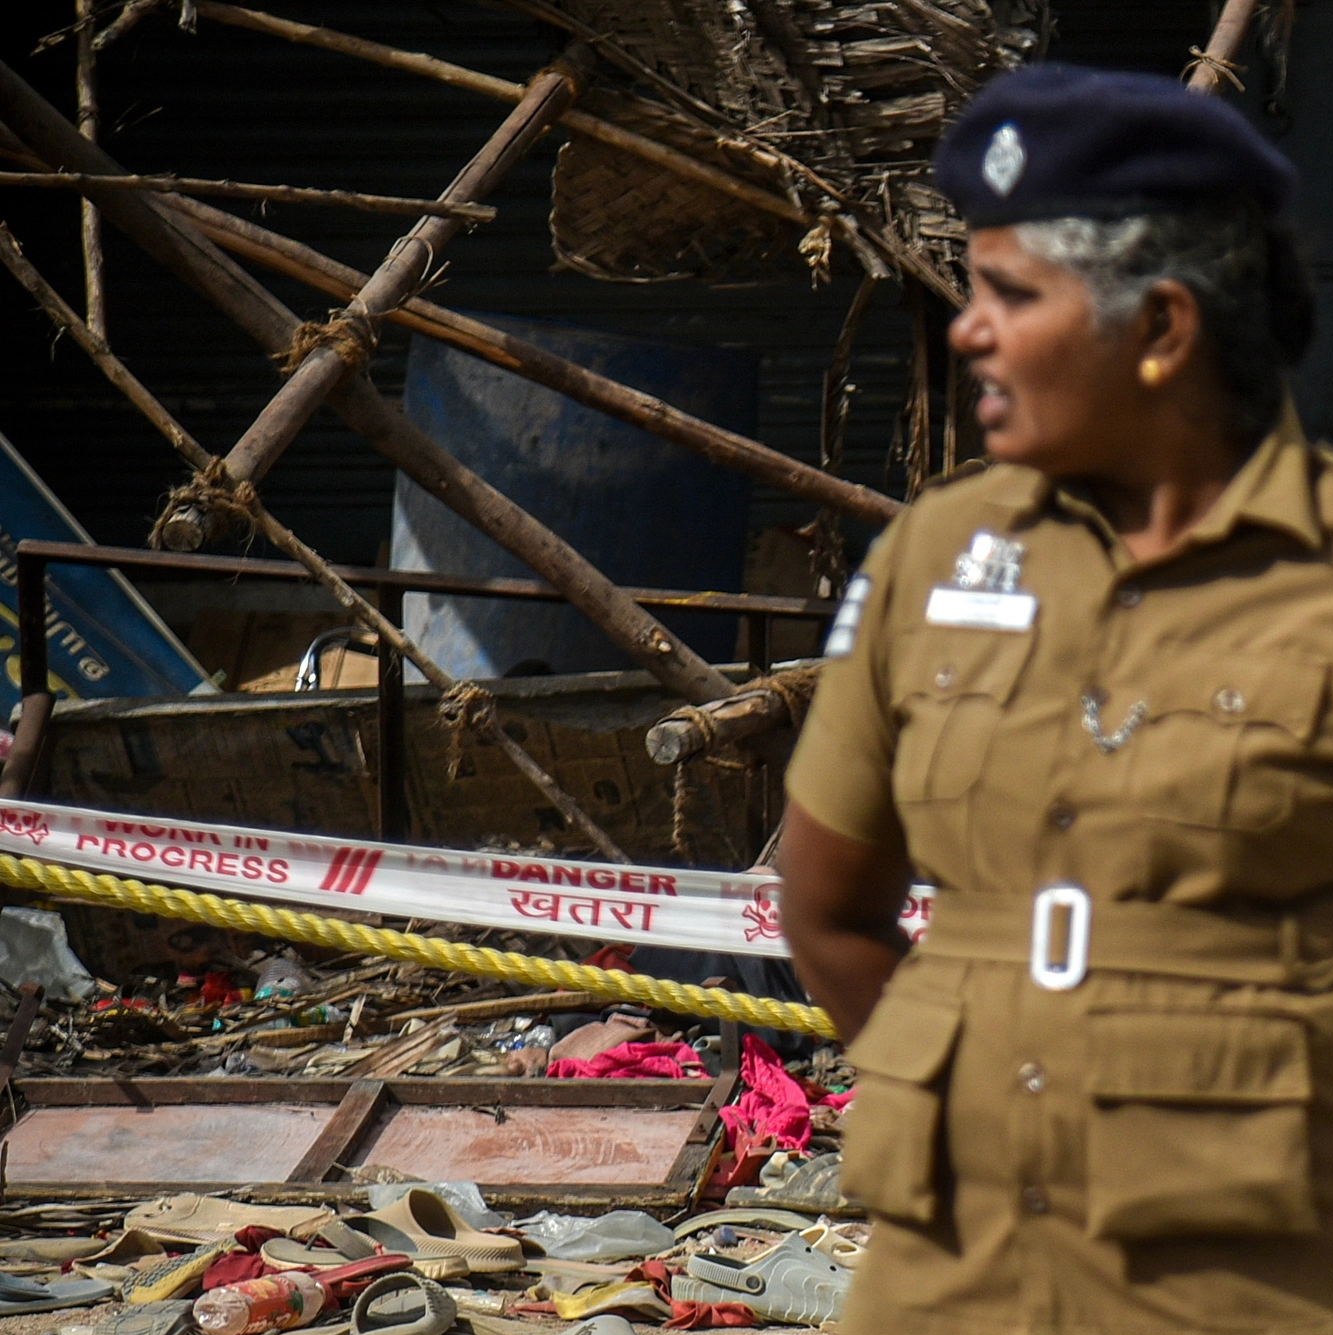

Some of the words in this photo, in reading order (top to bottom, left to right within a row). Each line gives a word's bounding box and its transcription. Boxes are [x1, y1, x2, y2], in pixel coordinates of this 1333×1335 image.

[76, 833, 290, 884] PROGRESS
[491, 859, 677, 897] DANGER
[507, 889, 659, 931] खतरा
